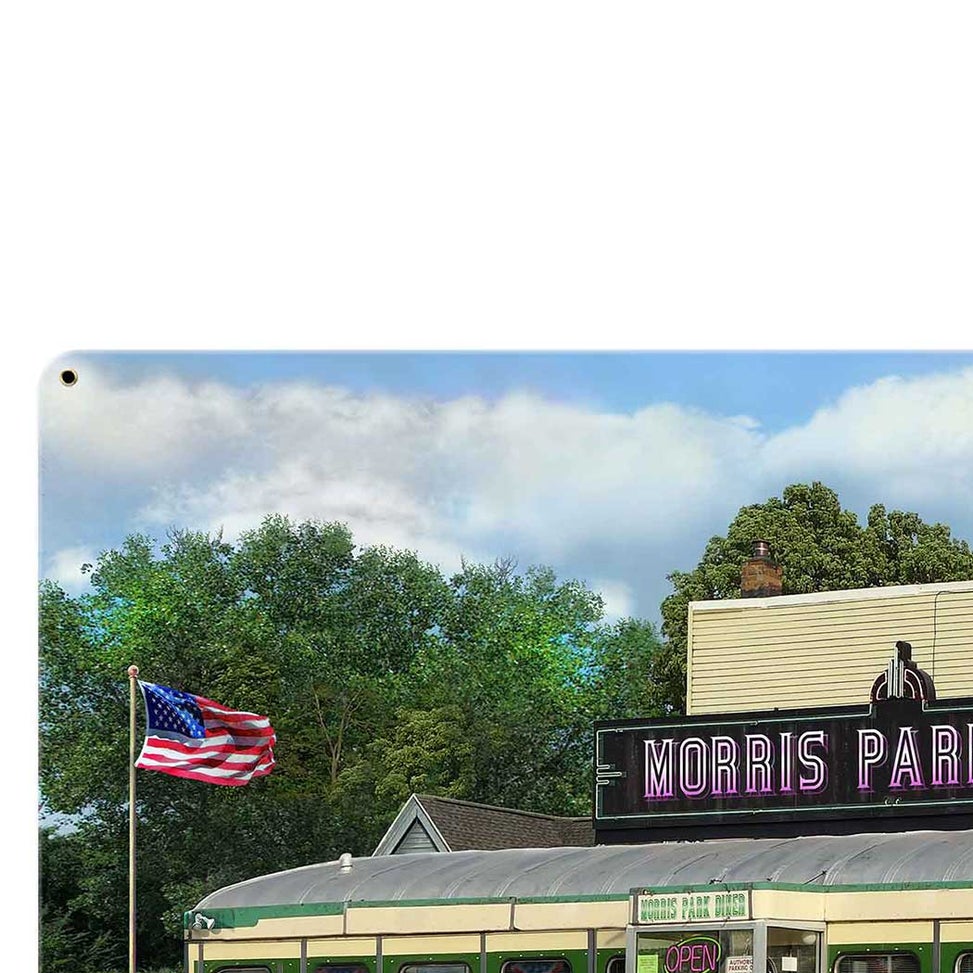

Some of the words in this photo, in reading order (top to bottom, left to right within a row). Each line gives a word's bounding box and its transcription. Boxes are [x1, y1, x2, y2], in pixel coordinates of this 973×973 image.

[643, 731, 829, 799] MORRIS
[641, 898, 678, 920] MORRIS
[681, 896, 710, 919] PARK
[715, 893, 746, 917] DINER
[665, 944, 717, 973] OPEN
